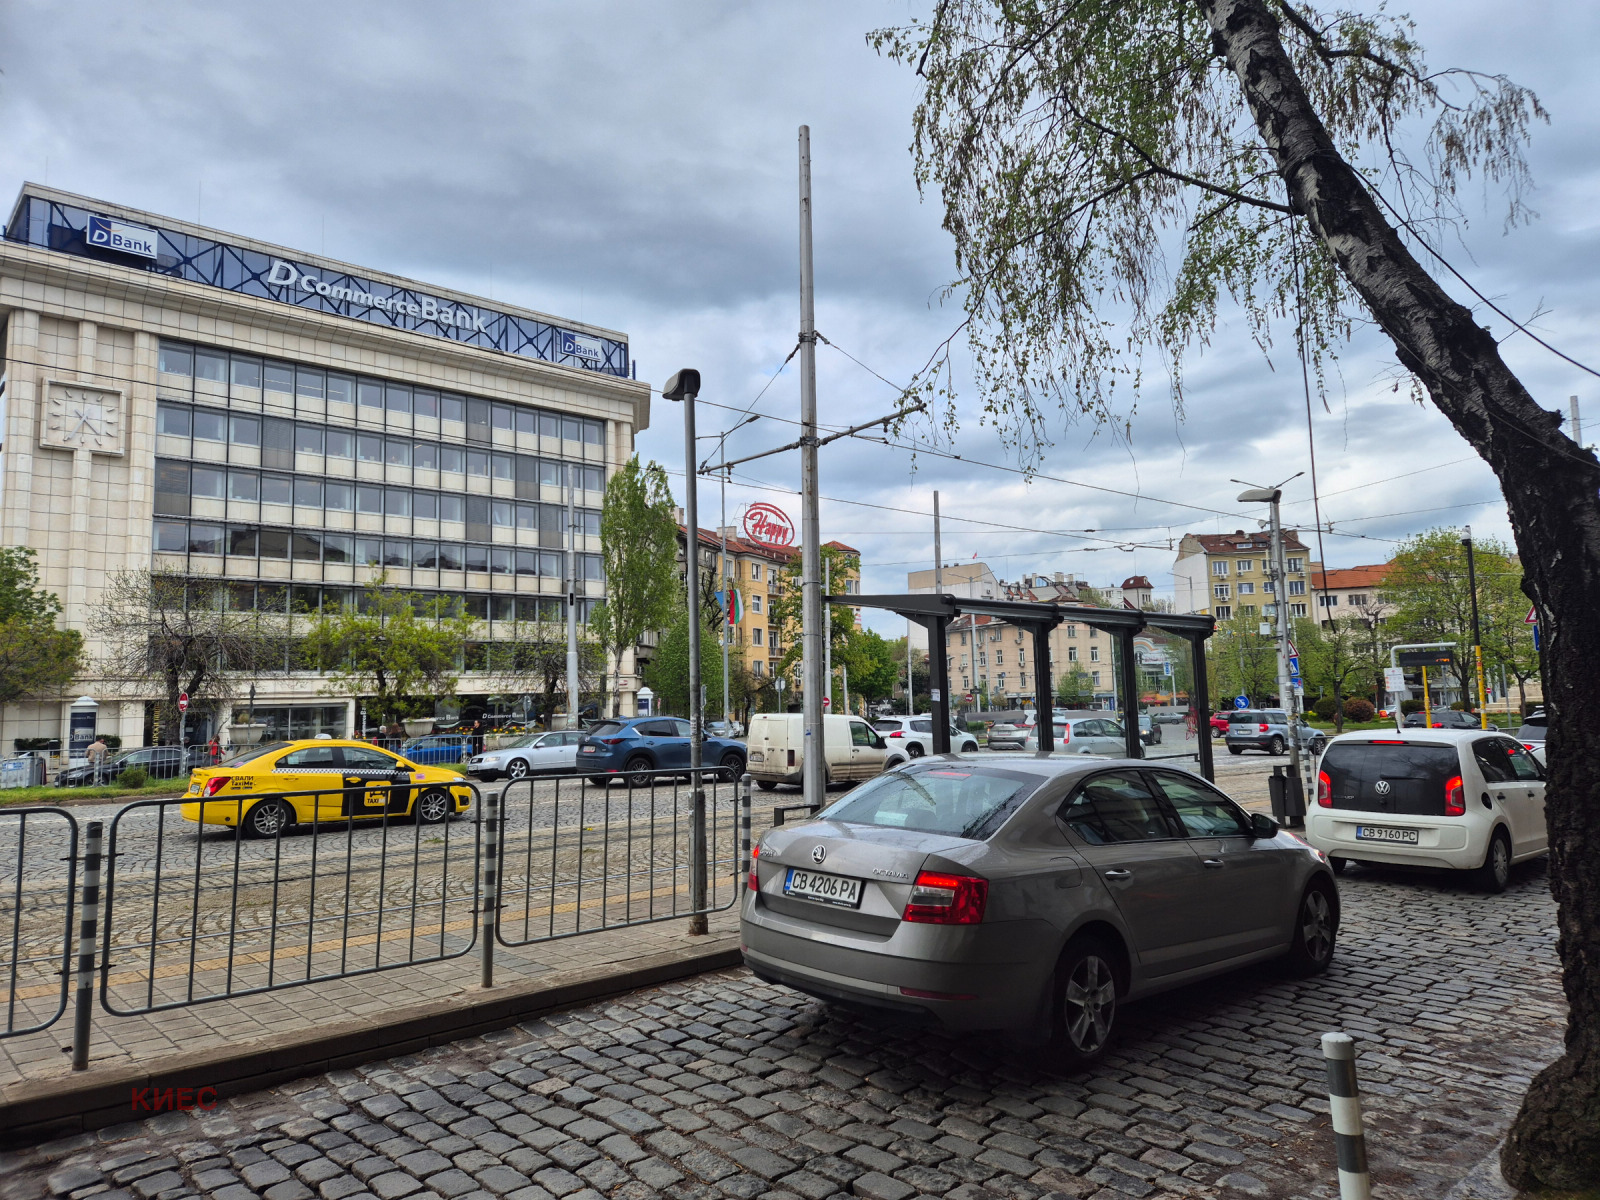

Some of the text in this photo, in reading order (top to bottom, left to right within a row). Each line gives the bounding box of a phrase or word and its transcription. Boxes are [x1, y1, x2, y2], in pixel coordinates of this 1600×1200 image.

[92, 229, 153, 253] D Bank
[267, 260, 298, 286] D
[564, 342, 599, 358] D Bank
[749, 511, 789, 545] Happy
[1362, 828, 1416, 841] CB 9160 PC
[792, 872, 857, 900] CB 4206 PA
[872, 868, 910, 880] OCTAVIA
